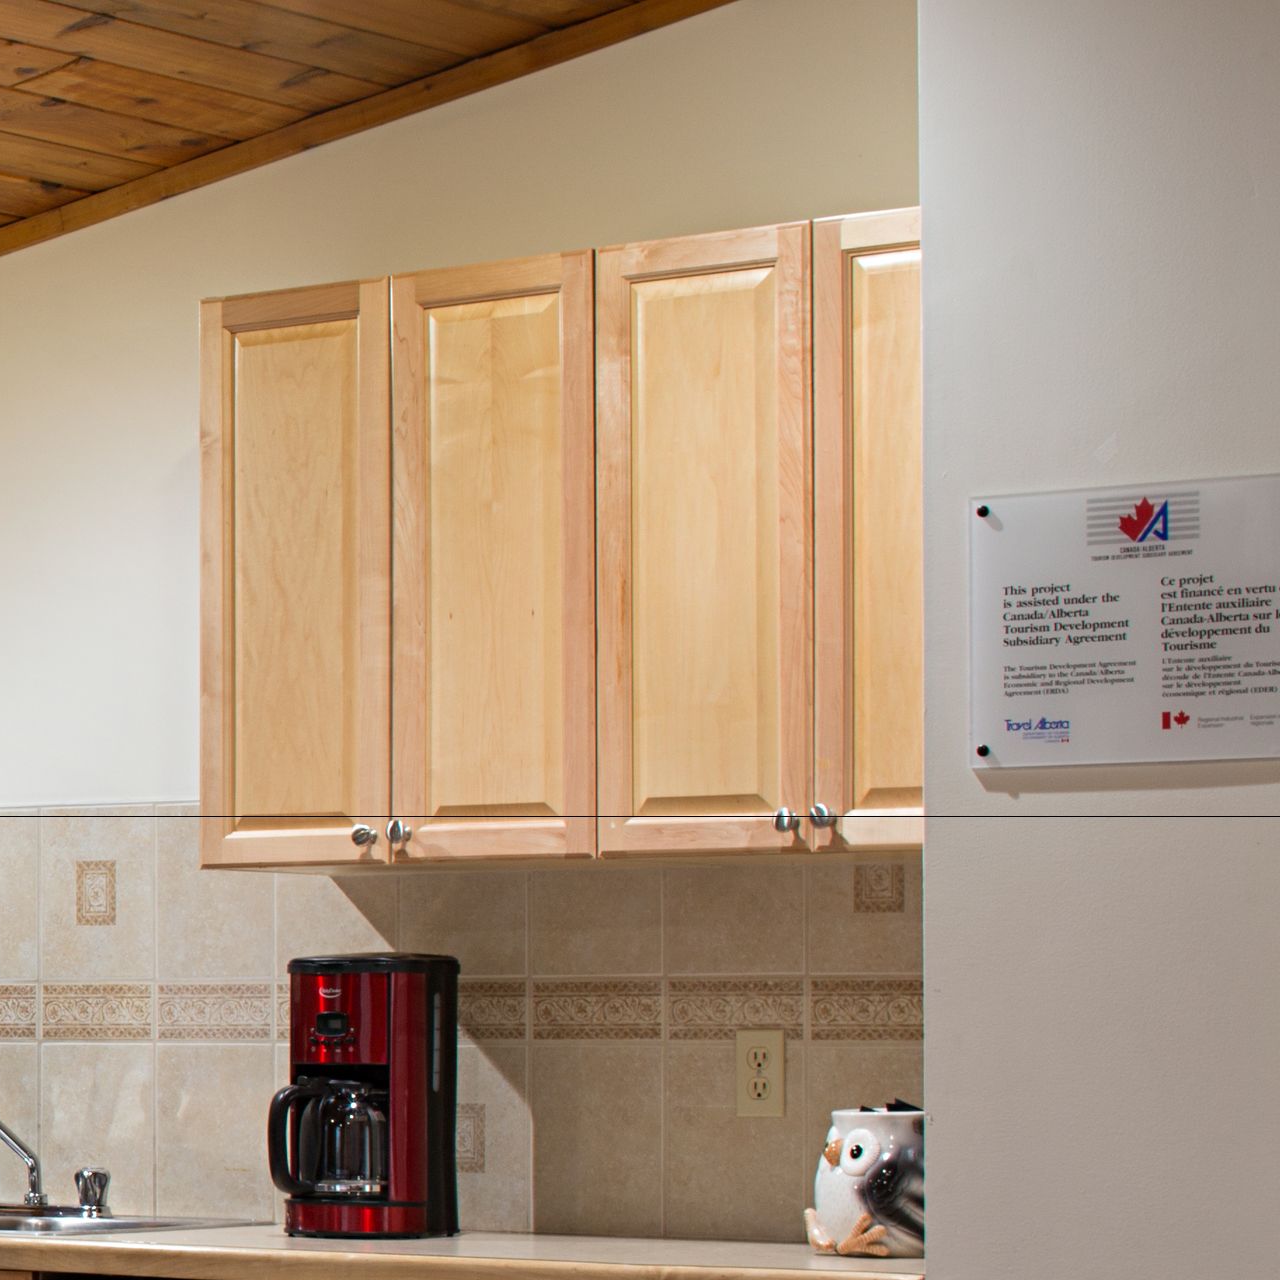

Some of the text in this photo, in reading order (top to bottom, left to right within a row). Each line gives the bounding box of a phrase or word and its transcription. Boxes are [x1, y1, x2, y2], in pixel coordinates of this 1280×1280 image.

[1160, 574, 1214, 588] Ce projet
[1003, 583, 1071, 597] This project
[1160, 585, 1276, 600] est financé en vertu
[1003, 593, 1120, 609] is assisted under the
[1161, 597, 1272, 613] l'Entente auxiliaire
[1003, 608, 1089, 622] Canada/Alberta
[1161, 613, 1250, 626] Canada-Alberta
[1252, 612, 1272, 620] sur
[1003, 619, 1129, 635] Tourism Development
[1161, 624, 1270, 639] développement du
[1003, 632, 1127, 647] Subsidiary Agreement
[1161, 641, 1217, 651] Tourisme
[1049, 663, 1096, 671] Development
[1098, 660, 1136, 668] Agreement
[1003, 681, 1038, 689] Economic
[1055, 679, 1085, 687] Regional
[1087, 677, 1134, 685] Development
[1003, 690, 1041, 698] Agreement
[1004, 717, 1070, 731] Travel Alberta
